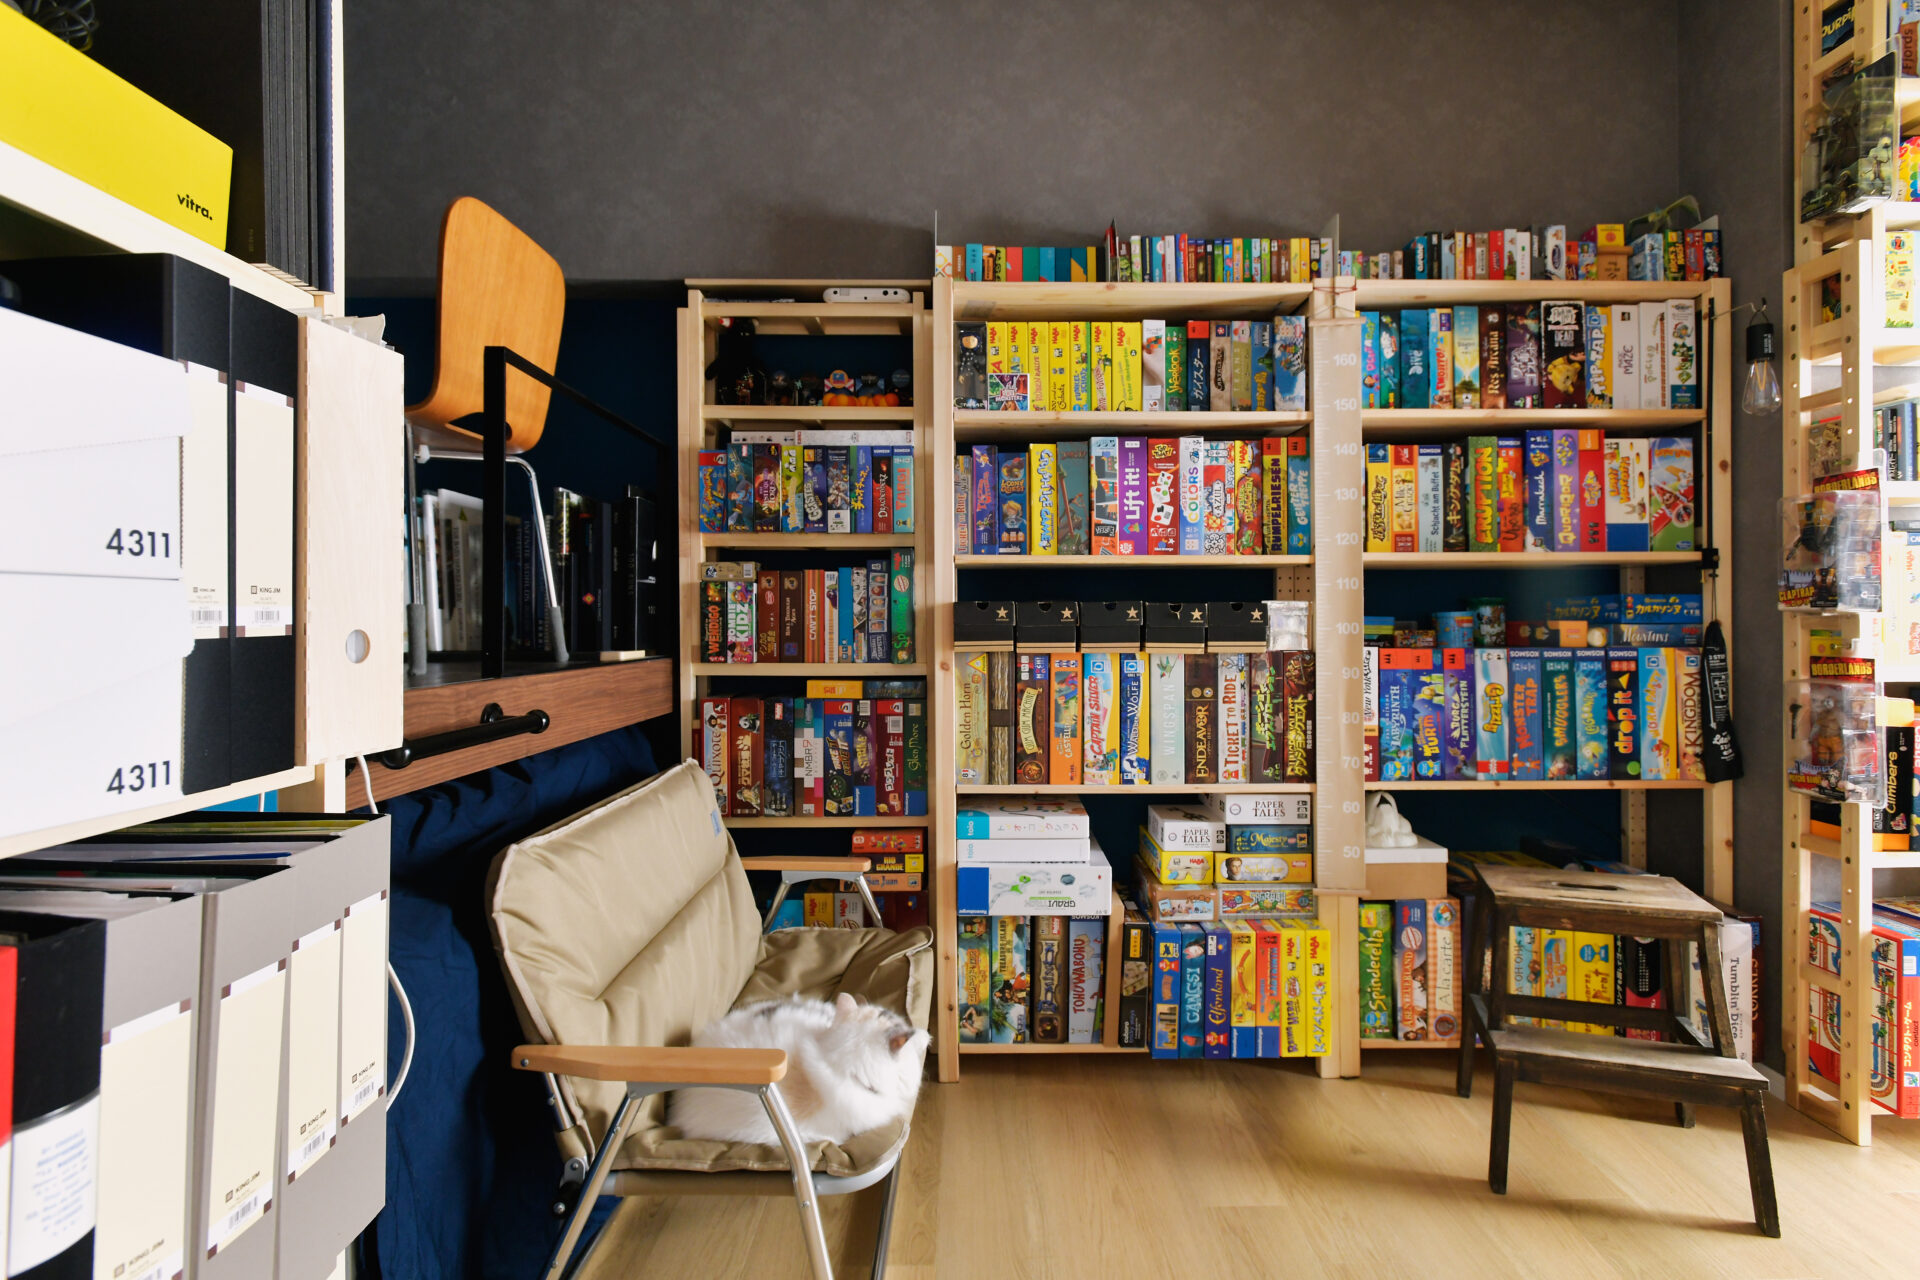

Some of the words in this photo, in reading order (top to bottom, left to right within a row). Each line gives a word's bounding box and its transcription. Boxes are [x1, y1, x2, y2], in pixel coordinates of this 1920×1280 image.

[177, 194, 213, 221] vitra.
[1334, 354, 1356, 365] 160
[1488, 331, 1499, 369] Arcana
[1591, 329, 1605, 364] TAP
[1488, 374, 1499, 394] Res
[1590, 366, 1606, 394] TIP
[1334, 399, 1356, 410] 150
[1239, 445, 1248, 464] HABA
[1334, 444, 1358, 455] 140
[895, 468, 907, 510] TARGI
[1124, 468, 1140, 486] it!
[1124, 489, 1144, 519] Lift
[1188, 467, 1199, 522] COLORS
[1214, 486, 1222, 511] AZUL
[1271, 458, 1281, 551] RUMPELRIESEN
[1335, 488, 1358, 499] 130
[1432, 494, 1438, 504] am
[1475, 446, 1493, 543] ERUPTION
[1536, 471, 1547, 525] Marrakech
[1559, 474, 1576, 544] QUORIDOR
[106, 528, 169, 558] 4311
[1336, 533, 1358, 545] 120
[1337, 578, 1358, 589] 110
[1779, 586, 1814, 602] CLAPTRAP
[708, 605, 721, 654] WENDIGO
[728, 604, 736, 642] ZOMBIE
[736, 604, 748, 642] KIDZ
[1337, 623, 1359, 634] 100
[1342, 667, 1359, 678] 90
[1812, 663, 1872, 676] BORDERLANDS
[960, 683, 971, 709] Horn
[1223, 675, 1237, 704] RIDE
[1526, 678, 1539, 716] TRAP
[1613, 691, 1632, 704] it
[1022, 691, 1035, 718] MACHINE
[1227, 707, 1236, 718] TO
[1343, 712, 1359, 723] 80
[1390, 685, 1402, 747] LABYRINTH
[1451, 701, 1460, 730] BURG
[1461, 680, 1470, 749] FLATTERSTEIN
[1513, 683, 1533, 750] MONSTER
[1553, 675, 1568, 747] SMUGGLERS
[1684, 673, 1703, 748] KINGDOM
[1021, 720, 1030, 734] GUM
[1163, 683, 1174, 756] WINGSPAN
[1614, 708, 1637, 754] drop
[960, 722, 971, 750] Golden
[1128, 728, 1138, 756] WALD
[1196, 703, 1209, 777] ENDEAVOR
[1224, 721, 1239, 767] TICKET
[710, 730, 724, 786] QUIXOTE
[804, 748, 813, 777] NMBR
[1343, 757, 1359, 769] 70
[107, 760, 171, 795] 4311
[1886, 751, 1898, 814] Climbers
[1253, 808, 1285, 817] TALES
[1255, 801, 1284, 809] PAPER
[1343, 802, 1360, 813] 60
[1181, 835, 1210, 843] TALES
[1250, 832, 1288, 848] Majesty
[1343, 847, 1360, 858] 50
[1287, 937, 1295, 957] HABA
[1310, 936, 1319, 959] HABA
[1072, 938, 1086, 1014] TOHUWABOHU
[1367, 930, 1387, 1011] Spinderella
[1185, 968, 1201, 1023] GANGSI
